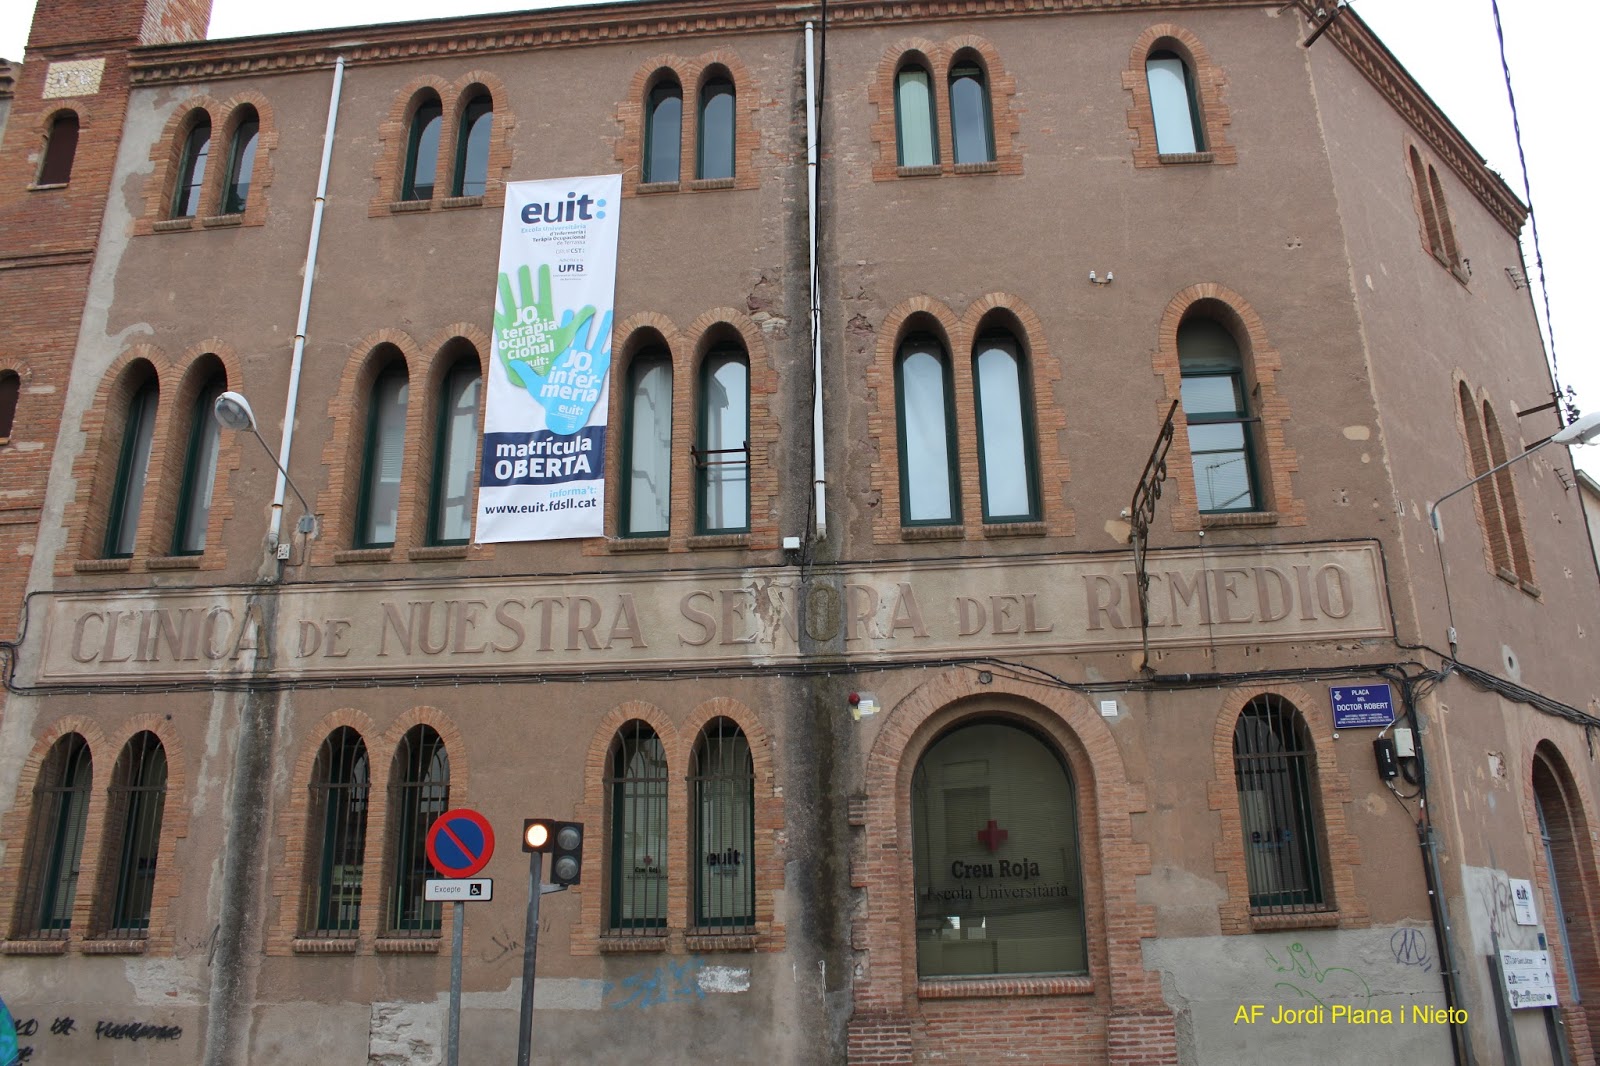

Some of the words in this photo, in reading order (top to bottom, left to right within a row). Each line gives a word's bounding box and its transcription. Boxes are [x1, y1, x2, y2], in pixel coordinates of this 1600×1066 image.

[507, 339, 555, 360] cional
[540, 382, 599, 402] meria
[496, 435, 592, 457] matrícula
[494, 453, 592, 480] OBERTA
[485, 497, 597, 514] www.euit.fdsll.cat
[296, 617, 352, 659] DE
[377, 592, 648, 657] NUESTRA
[956, 592, 1055, 637] DEL
[1082, 562, 1354, 631] REMEDIO
[1336, 703, 1363, 712] DOCTOR
[1363, 702, 1389, 711] ROBERT
[951, 859, 995, 879] Creu
[998, 857, 1041, 880] Roja
[434, 885, 461, 894] Excepte
